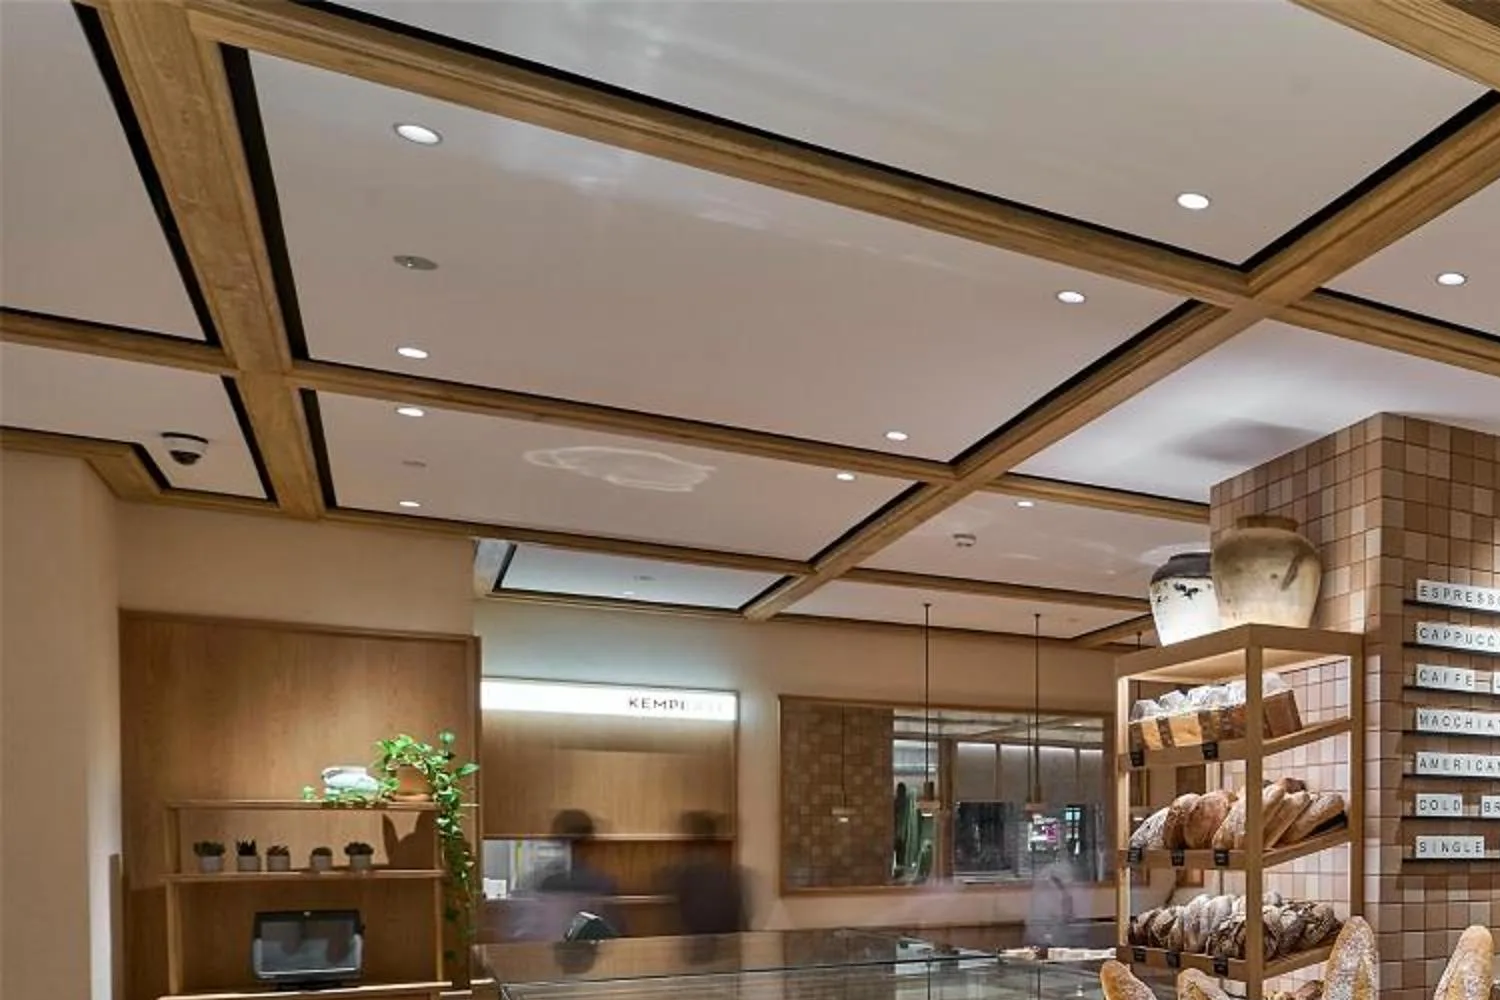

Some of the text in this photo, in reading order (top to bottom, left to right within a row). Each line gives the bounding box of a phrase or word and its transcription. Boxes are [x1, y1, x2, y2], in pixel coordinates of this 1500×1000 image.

[1419, 669, 1474, 687] CAFFE
[1419, 799, 1462, 812] COLD
[1419, 842, 1482, 854] SINGLE
